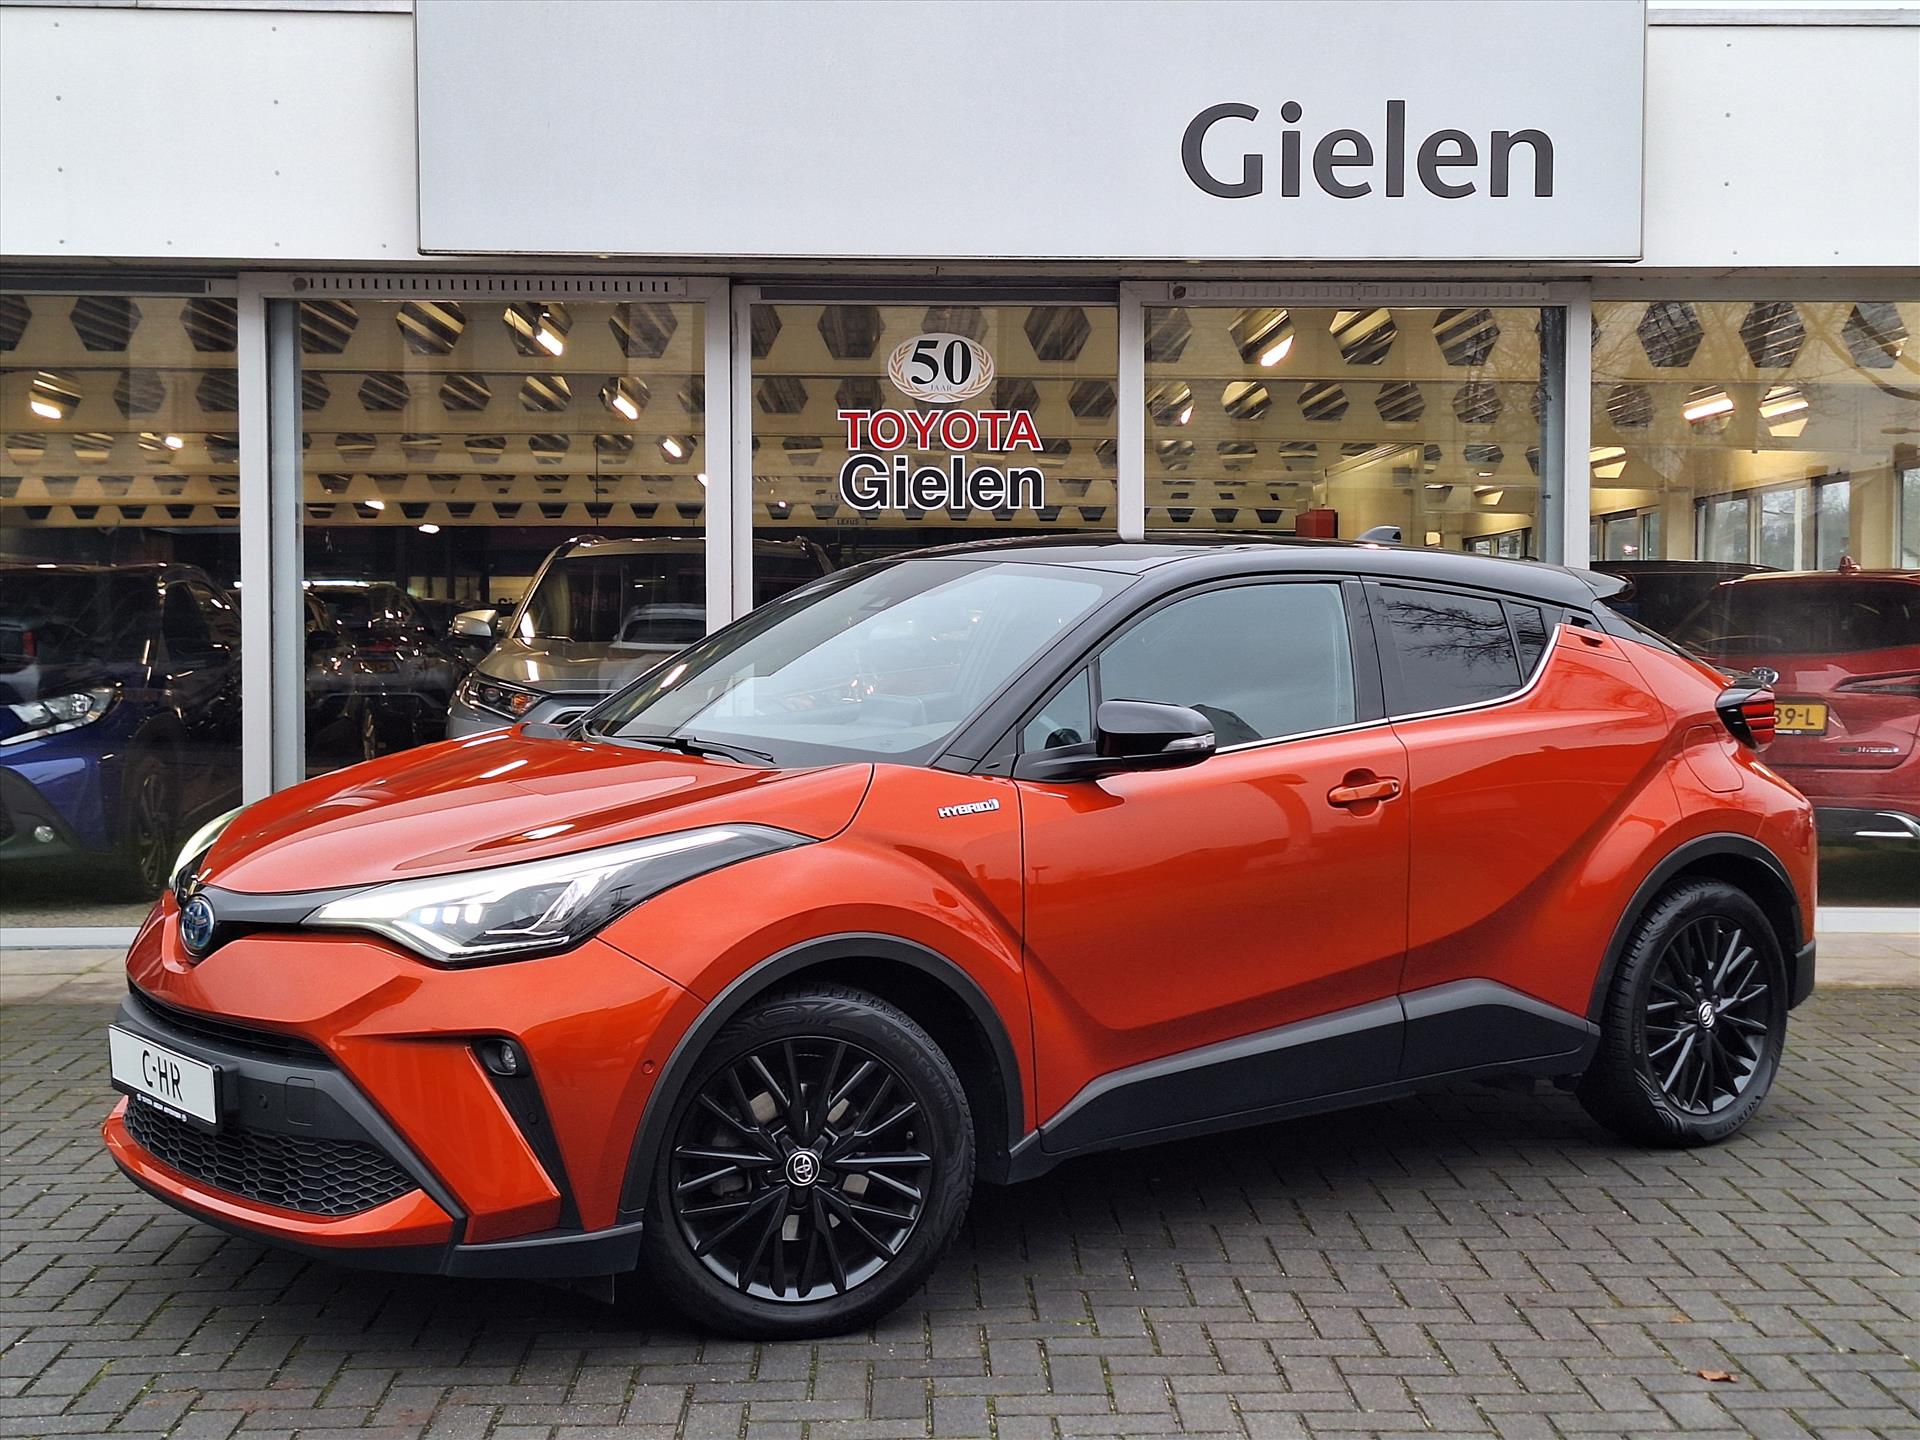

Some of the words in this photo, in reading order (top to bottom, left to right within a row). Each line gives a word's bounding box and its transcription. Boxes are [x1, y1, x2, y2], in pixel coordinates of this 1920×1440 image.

[1181, 100, 1554, 199] Gielen
[911, 340, 972, 385] 50
[929, 384, 953, 392] JAAR
[838, 409, 1043, 451] TOYOTA
[839, 453, 1045, 510] Gielen
[938, 799, 993, 818] HYBRID
[142, 1050, 183, 1102] C-HR
